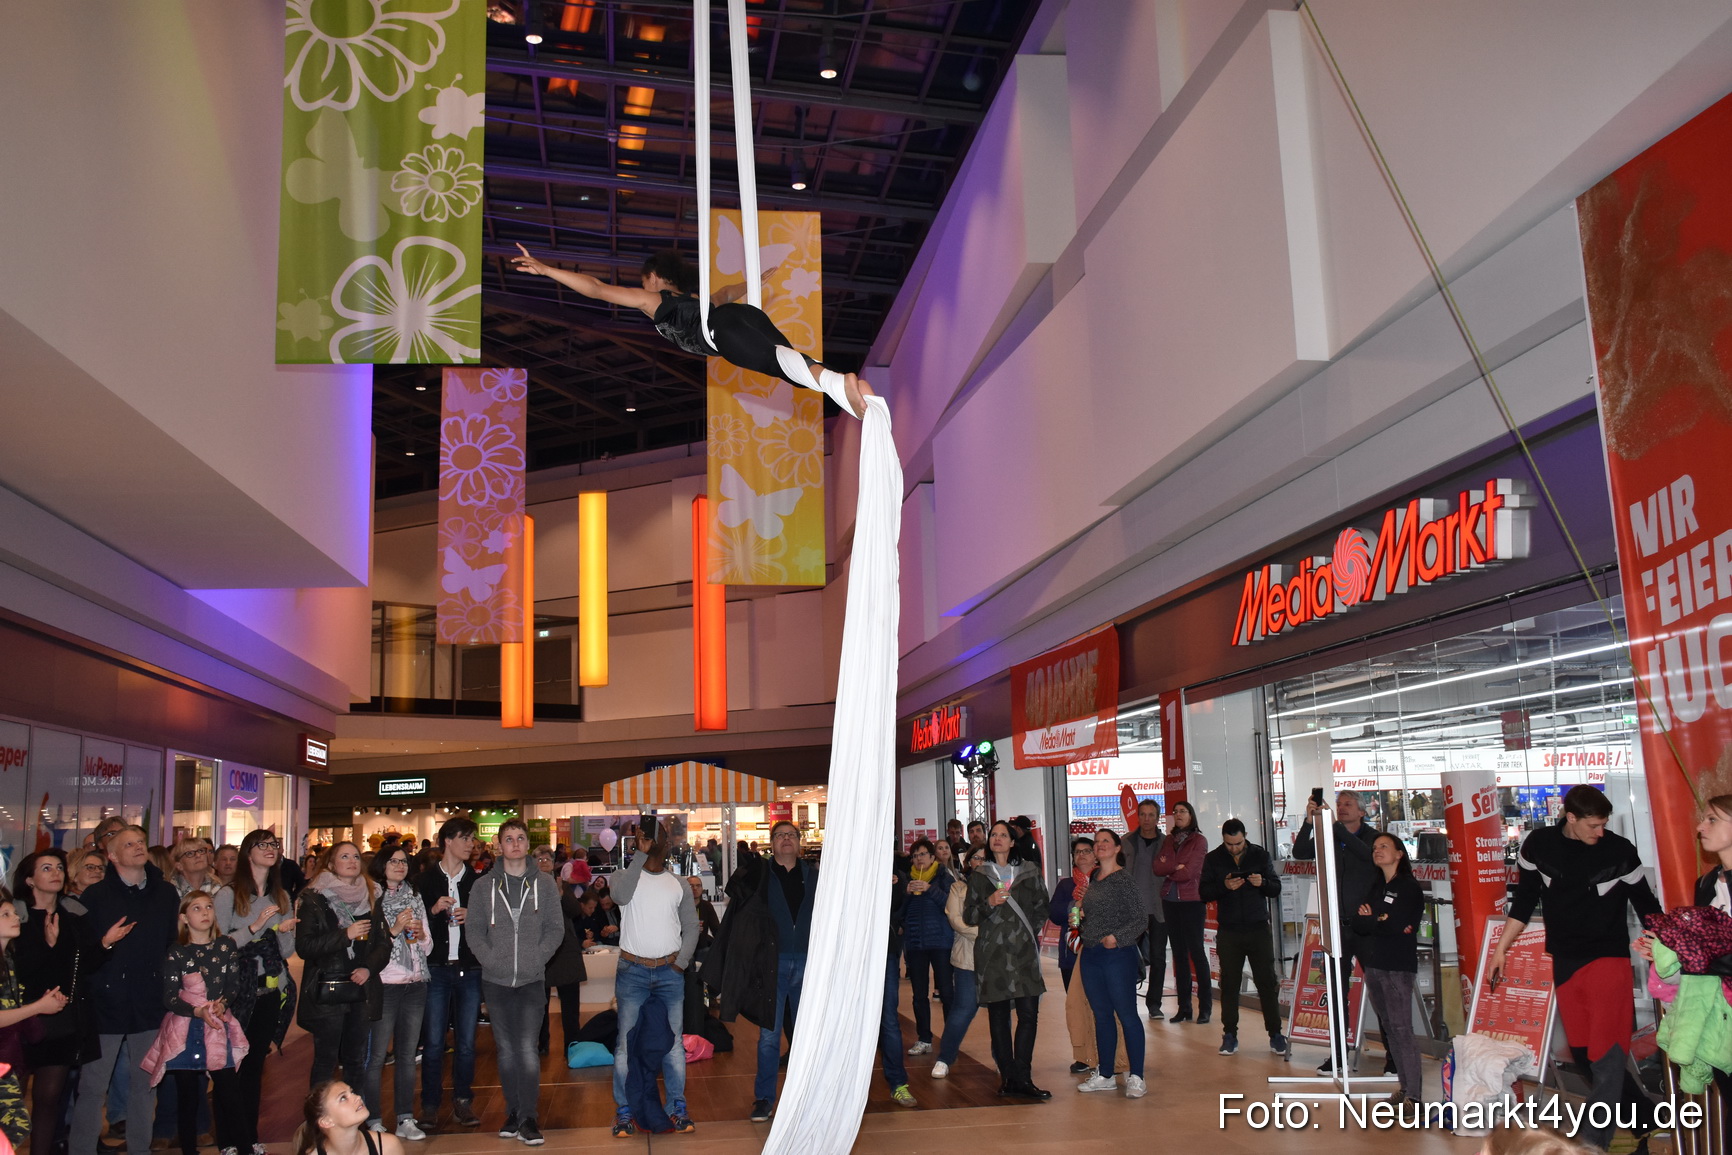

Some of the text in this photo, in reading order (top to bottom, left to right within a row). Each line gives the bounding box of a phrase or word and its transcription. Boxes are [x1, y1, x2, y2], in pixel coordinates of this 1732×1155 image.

[1544, 752, 1613, 767] SOFTWARE
[230, 769, 258, 793] COSMO
[381, 782, 423, 792] LEBENSRAUM
[1475, 836, 1497, 848] Strom
